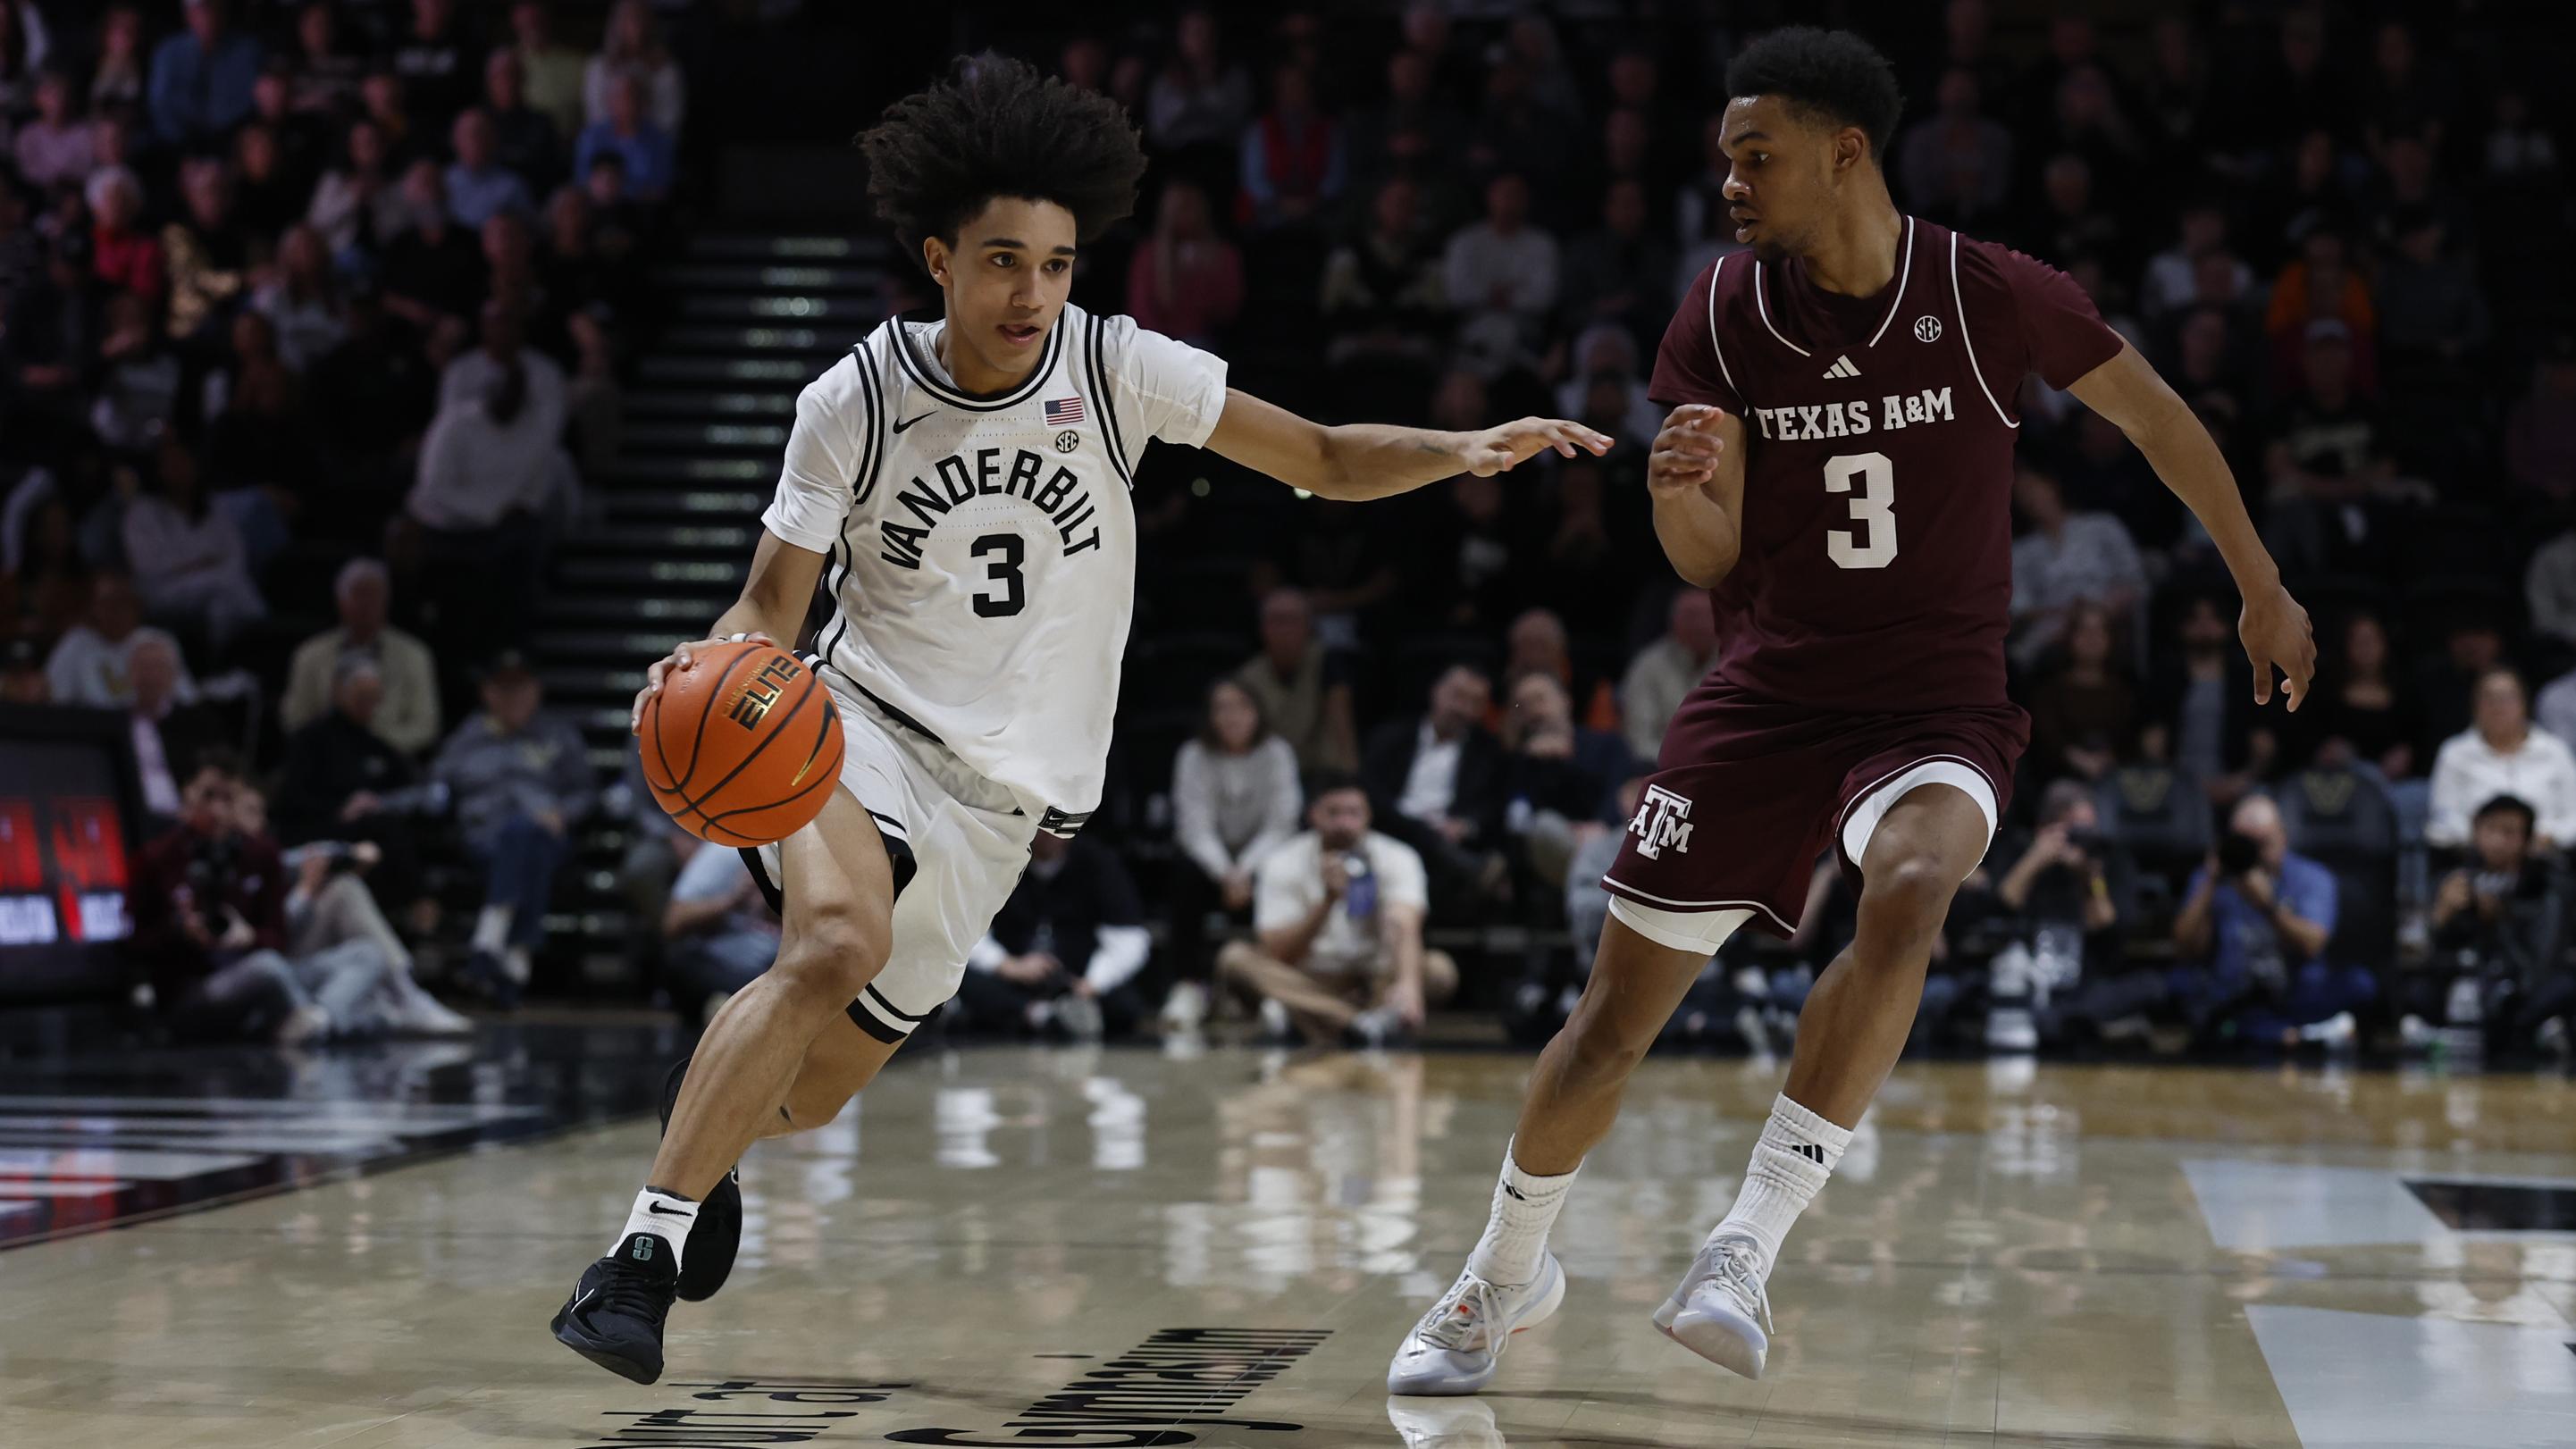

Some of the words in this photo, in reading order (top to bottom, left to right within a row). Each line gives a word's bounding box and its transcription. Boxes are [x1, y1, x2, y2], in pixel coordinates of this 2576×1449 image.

[1914, 315, 1942, 343] SEC
[1056, 431, 1079, 453] SEC
[1754, 400, 1872, 440] TEXAS
[1883, 386, 1955, 431] A&M
[881, 448, 1100, 570] VANDERBILT
[1823, 452, 1898, 569] 3
[970, 533, 1026, 618] 3
[729, 655, 801, 733] ELITE
[884, 1328, 1334, 1448] Gymnasium
[574, 1409, 859, 1449] urt
